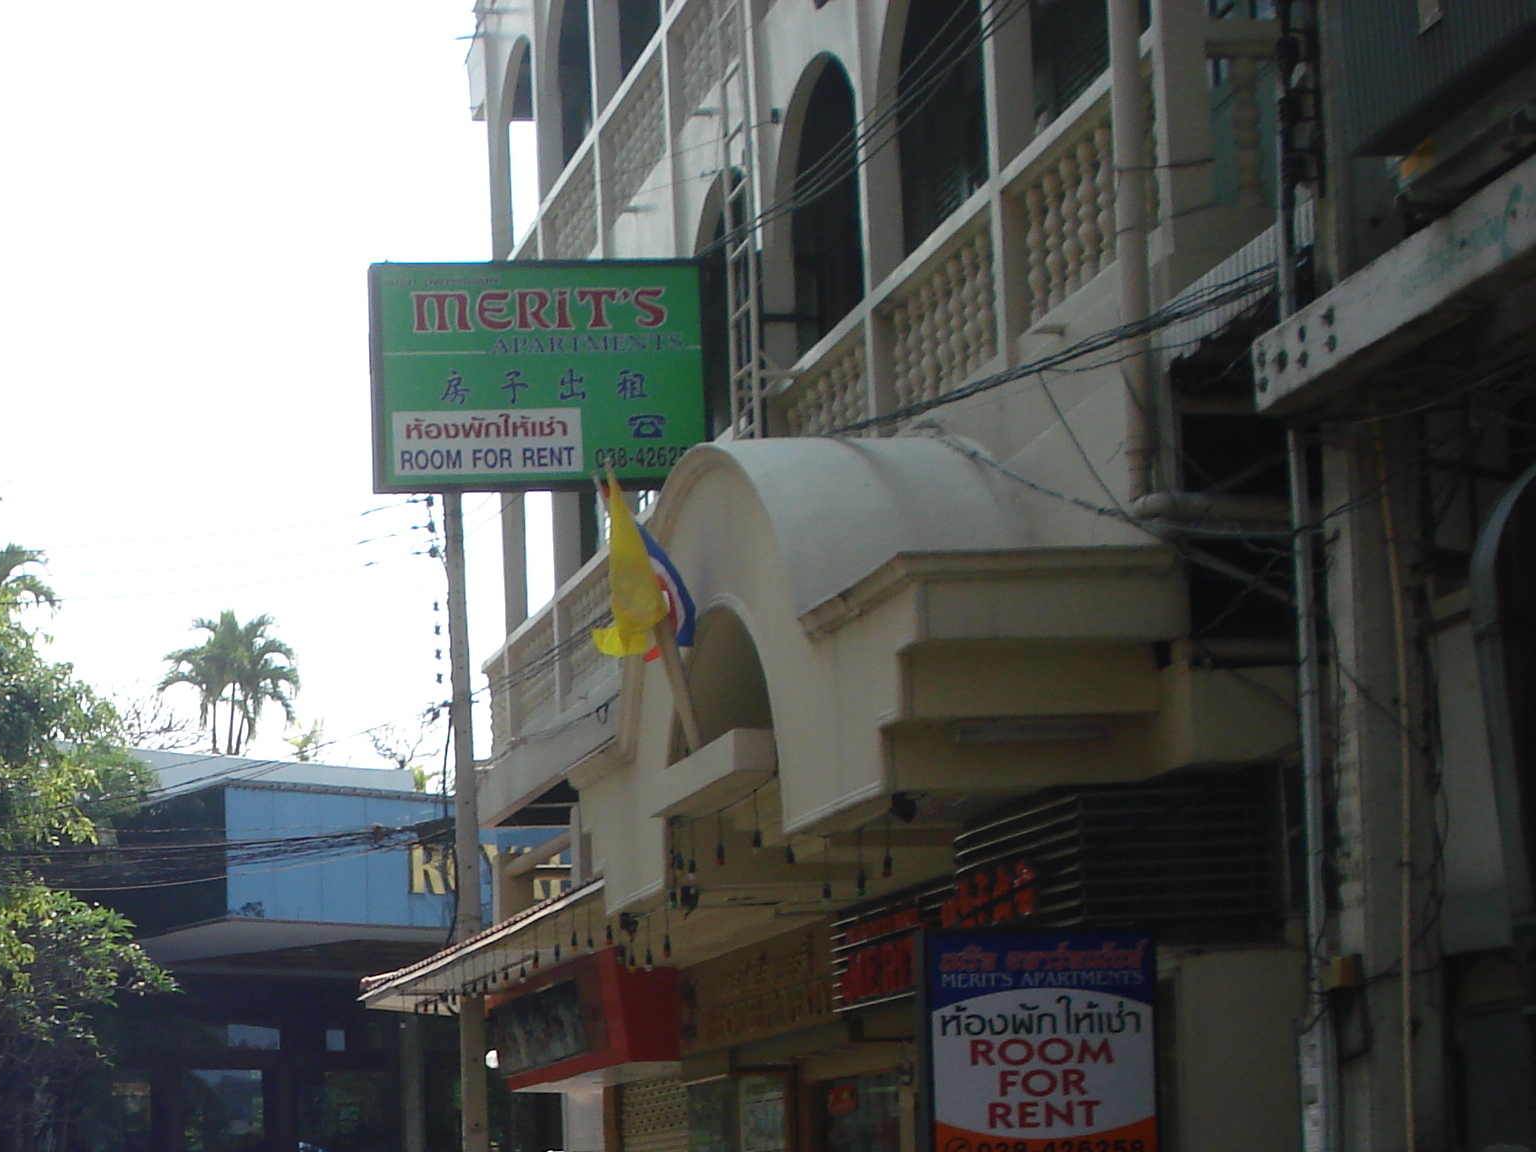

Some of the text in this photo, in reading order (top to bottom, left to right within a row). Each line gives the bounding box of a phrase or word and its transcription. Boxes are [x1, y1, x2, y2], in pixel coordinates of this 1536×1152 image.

[411, 287, 667, 333] MERIT'S
[491, 333, 684, 354] APARTMENTS
[405, 414, 569, 440] ห้องพักให้เช่า
[401, 446, 576, 470] ROOM FOR RENT
[941, 970, 1145, 989] MERIT'S APARTMENTS
[941, 996, 1142, 1037] ห้องพักให้เช่า
[969, 1038, 1115, 1067] ROOM
[999, 1069, 1088, 1097] FOR
[987, 1100, 1101, 1130] RENT
